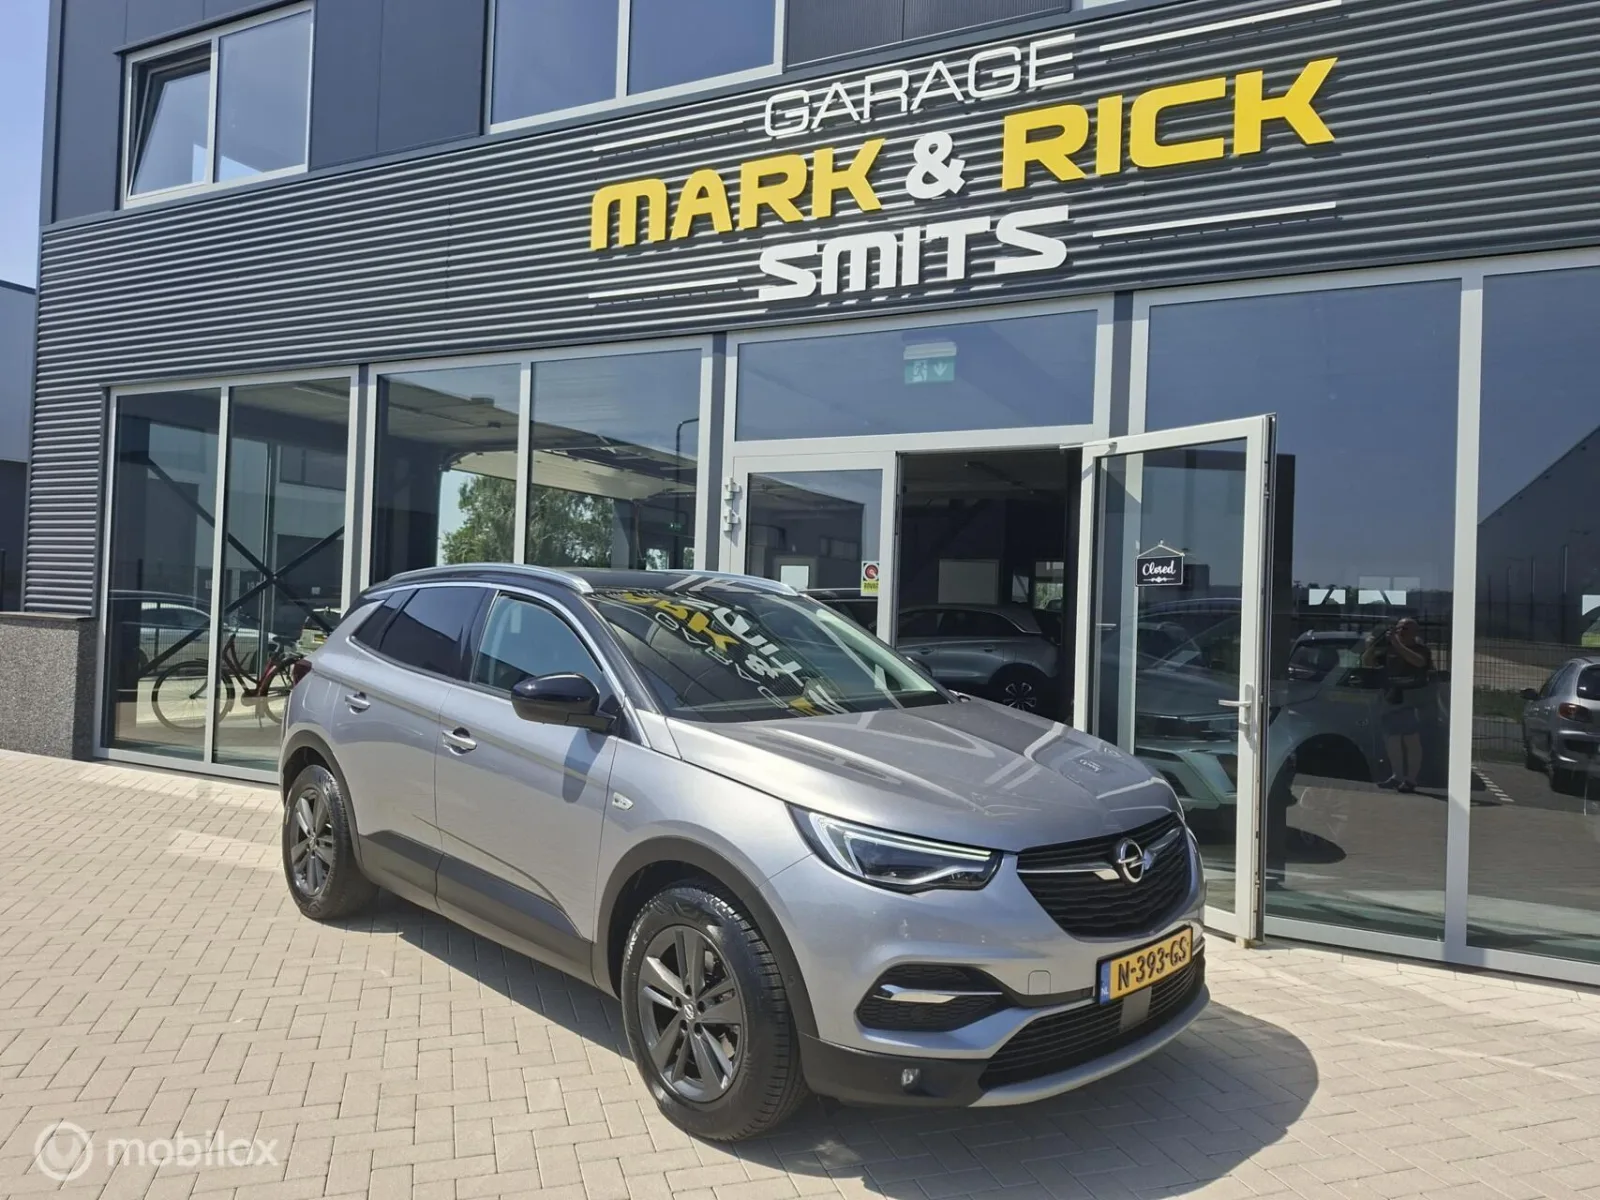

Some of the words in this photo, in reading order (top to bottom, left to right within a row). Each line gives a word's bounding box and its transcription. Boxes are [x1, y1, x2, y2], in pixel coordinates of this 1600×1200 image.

[764, 33, 1076, 137] GARAGE
[590, 138, 886, 251] MARK
[906, 131, 966, 199] &
[1001, 57, 1339, 191] RICK
[758, 205, 1069, 300] SMITS
[1142, 560, 1177, 576] Closed
[1117, 936, 1188, 991] N-393-GS
